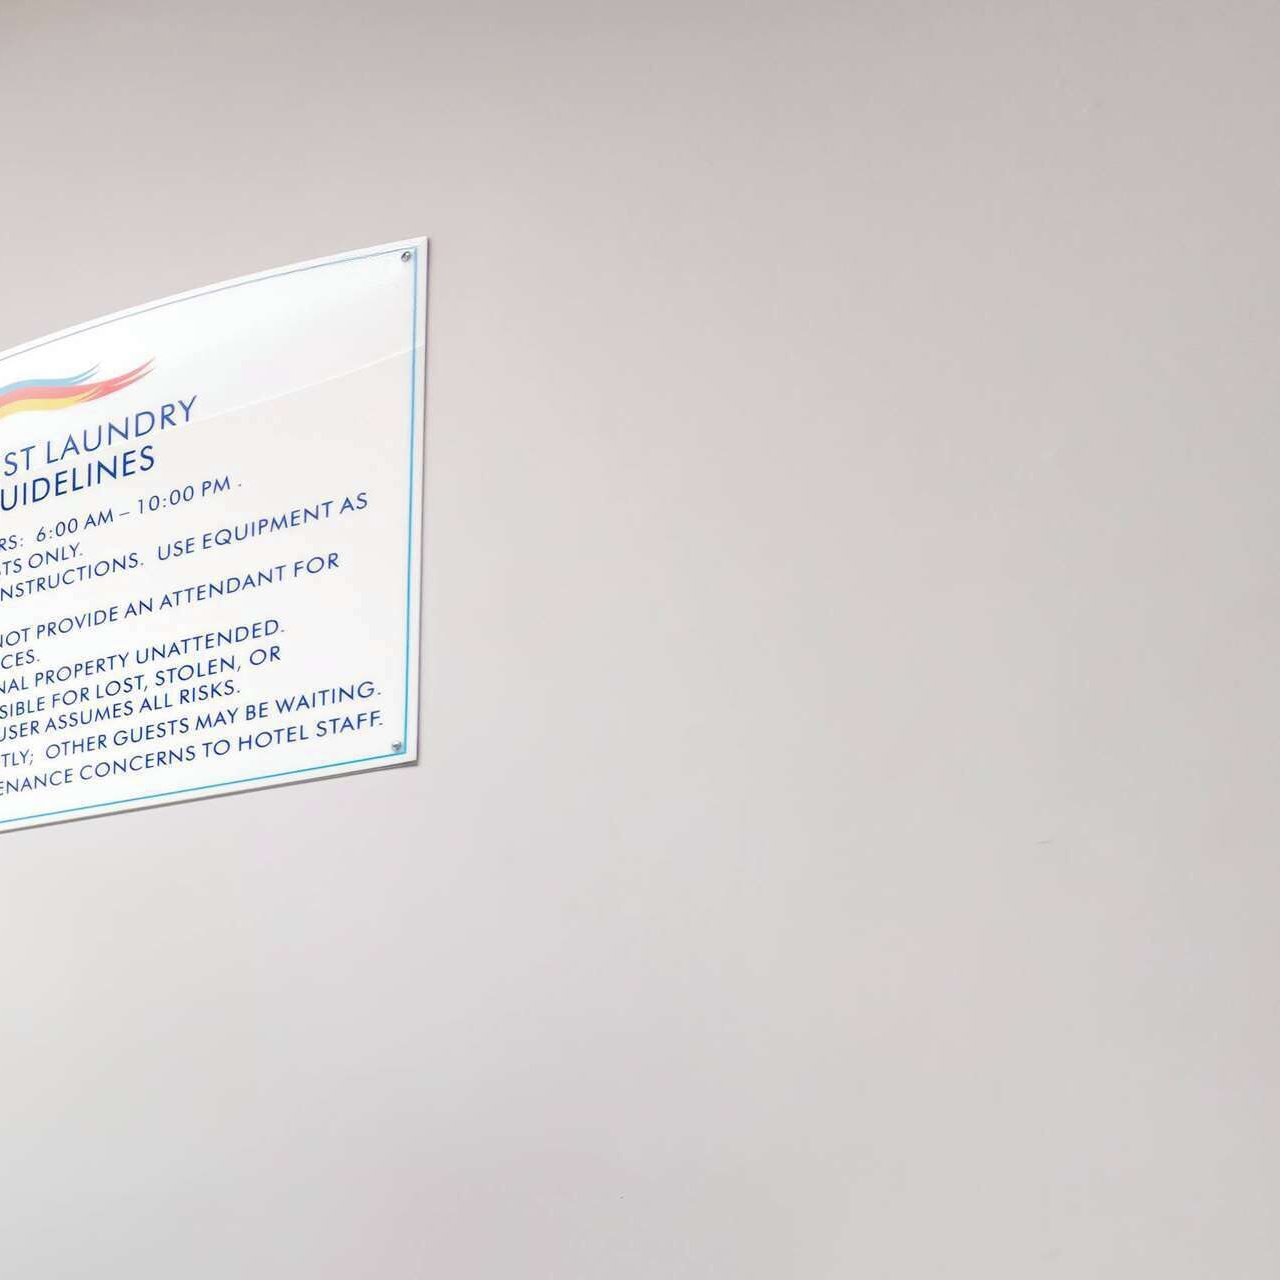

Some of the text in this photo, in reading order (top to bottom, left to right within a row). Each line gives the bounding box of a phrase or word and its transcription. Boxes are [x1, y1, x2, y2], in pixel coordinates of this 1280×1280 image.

[46, 394, 198, 465] LAUNDRY
[35, 517, 79, 543] 6:00
[83, 507, 114, 530] AM
[137, 485, 195, 515] 10:00
[201, 475, 231, 497] PM
[157, 536, 196, 561] USE
[202, 500, 334, 550] EQUIPMENT
[338, 491, 368, 515] AS
[27, 541, 84, 569] ONLY.
[36, 605, 119, 640] PROVIDE
[123, 597, 154, 619] AN
[158, 564, 287, 611] ATTENDANT
[293, 551, 340, 578] FOR
[34, 651, 130, 688] PROPERTY
[135, 619, 285, 665] UNATTENDED.
[51, 686, 90, 709] FOR
[96, 673, 148, 700] LOST,
[154, 655, 242, 687] STOLEN,
[248, 645, 282, 667] OR
[44, 699, 134, 733] ASSUMES
[138, 692, 174, 714] ALL
[179, 679, 241, 705] RISKS.
[45, 733, 108, 760] OTHER
[112, 717, 190, 747] GUESTS
[194, 707, 239, 731] MAY
[245, 701, 269, 721] BE
[274, 680, 382, 715] WAITING.
[79, 745, 196, 781] CONCERNS
[201, 739, 231, 759] TO
[238, 724, 310, 752] HOTEL
[315, 709, 384, 738] STAFF.
